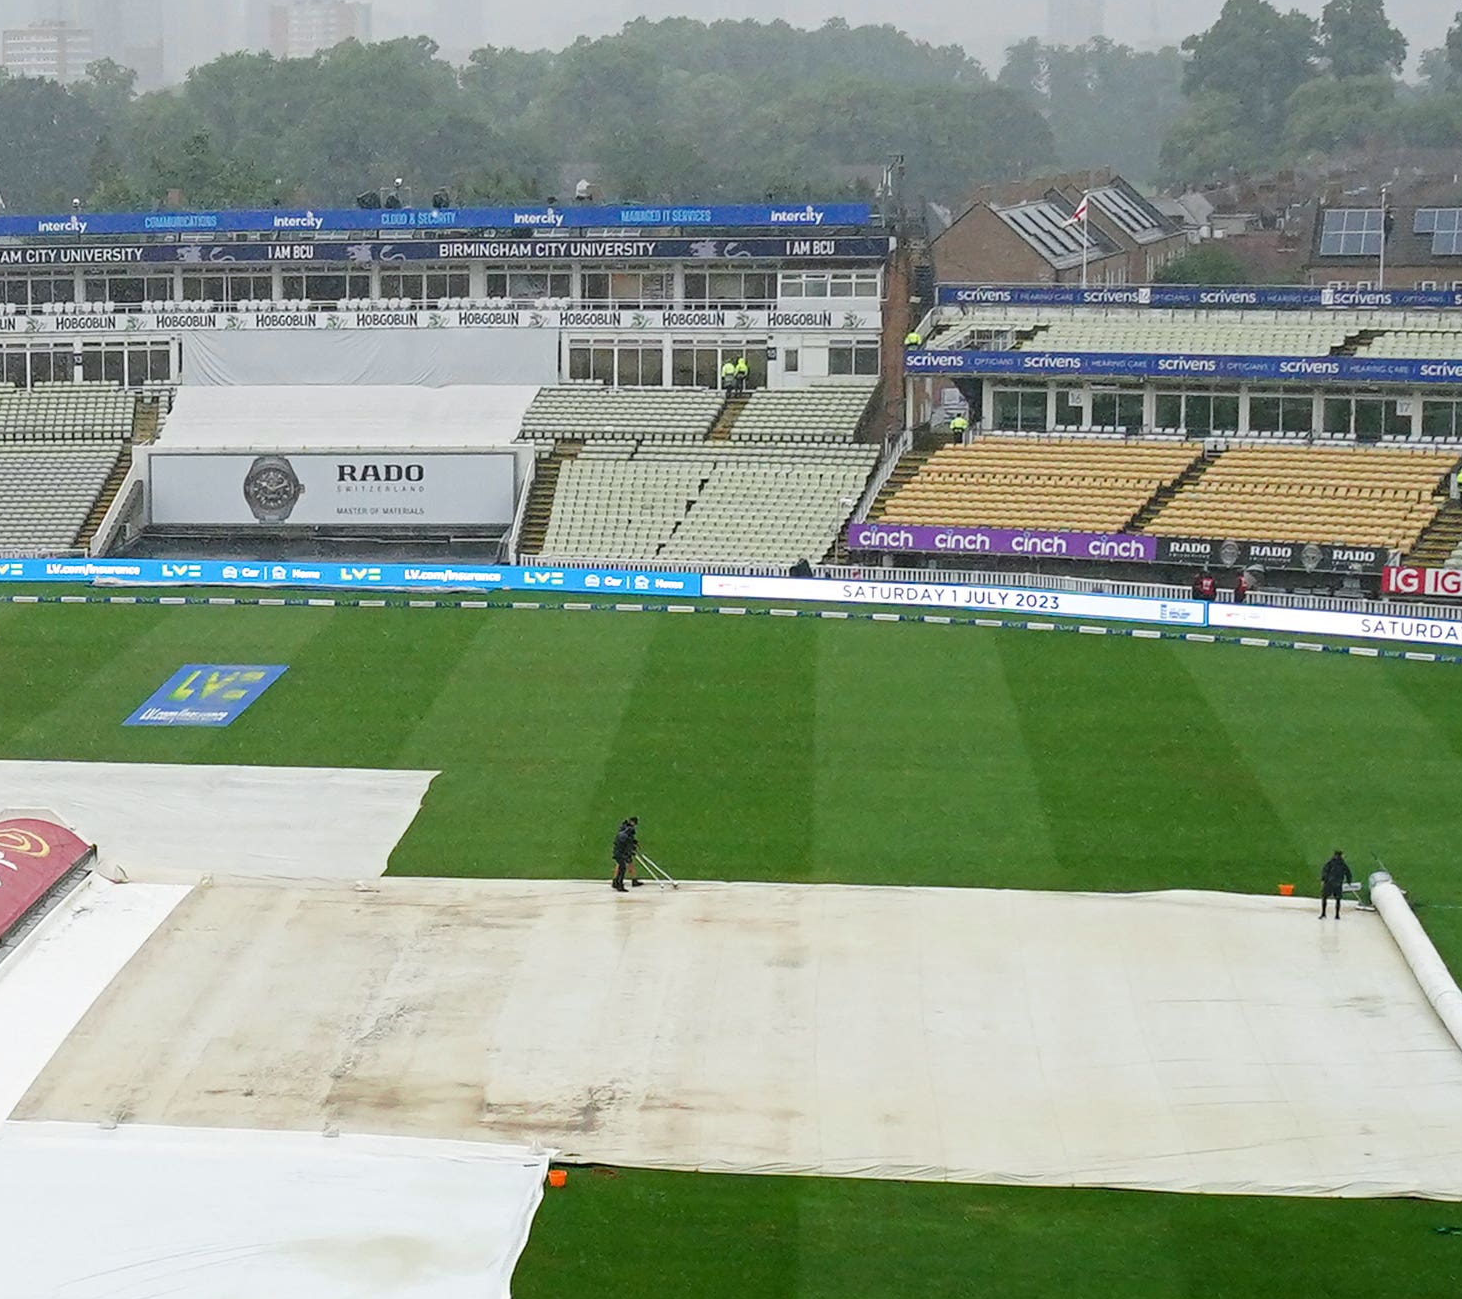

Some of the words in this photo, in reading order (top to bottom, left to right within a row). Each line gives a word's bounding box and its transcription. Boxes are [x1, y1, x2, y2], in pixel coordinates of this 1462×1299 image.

[25, 250, 57, 263] CITY
[61, 248, 143, 262] UNIVERSITY
[439, 243, 532, 258] BIRMINGHAM
[535, 242, 568, 256] CITY
[571, 242, 655, 256] UNIVERSITY
[792, 241, 811, 255] AM
[813, 241, 835, 255] BCU
[957, 288, 1011, 302] scrivens
[156, 315, 216, 328] HOBGOBLIN
[357, 313, 417, 327] HOBGOBLIN
[767, 311, 831, 326] HOBGOBLIN
[906, 352, 963, 368] scrivens
[1157, 357, 1215, 371] scrivens
[1279, 359, 1339, 374] scrivens
[1070, 392, 1082, 405] 16
[1399, 401, 1411, 413] 17
[336, 464, 425, 482] RADO
[336, 507, 368, 516] MASTER
[380, 507, 425, 516] MATERIALS
[859, 526, 913, 547] cinch
[935, 529, 990, 550] cinch
[1011, 532, 1066, 554] cinch
[1088, 535, 1144, 558] cinch
[1170, 541, 1211, 555] RADO
[1332, 549, 1375, 562] RADO
[1389, 568, 1421, 594] IG
[843, 585, 945, 603] SATURDAY
[964, 590, 1008, 606] JULY
[1016, 593, 1059, 609] 2023
